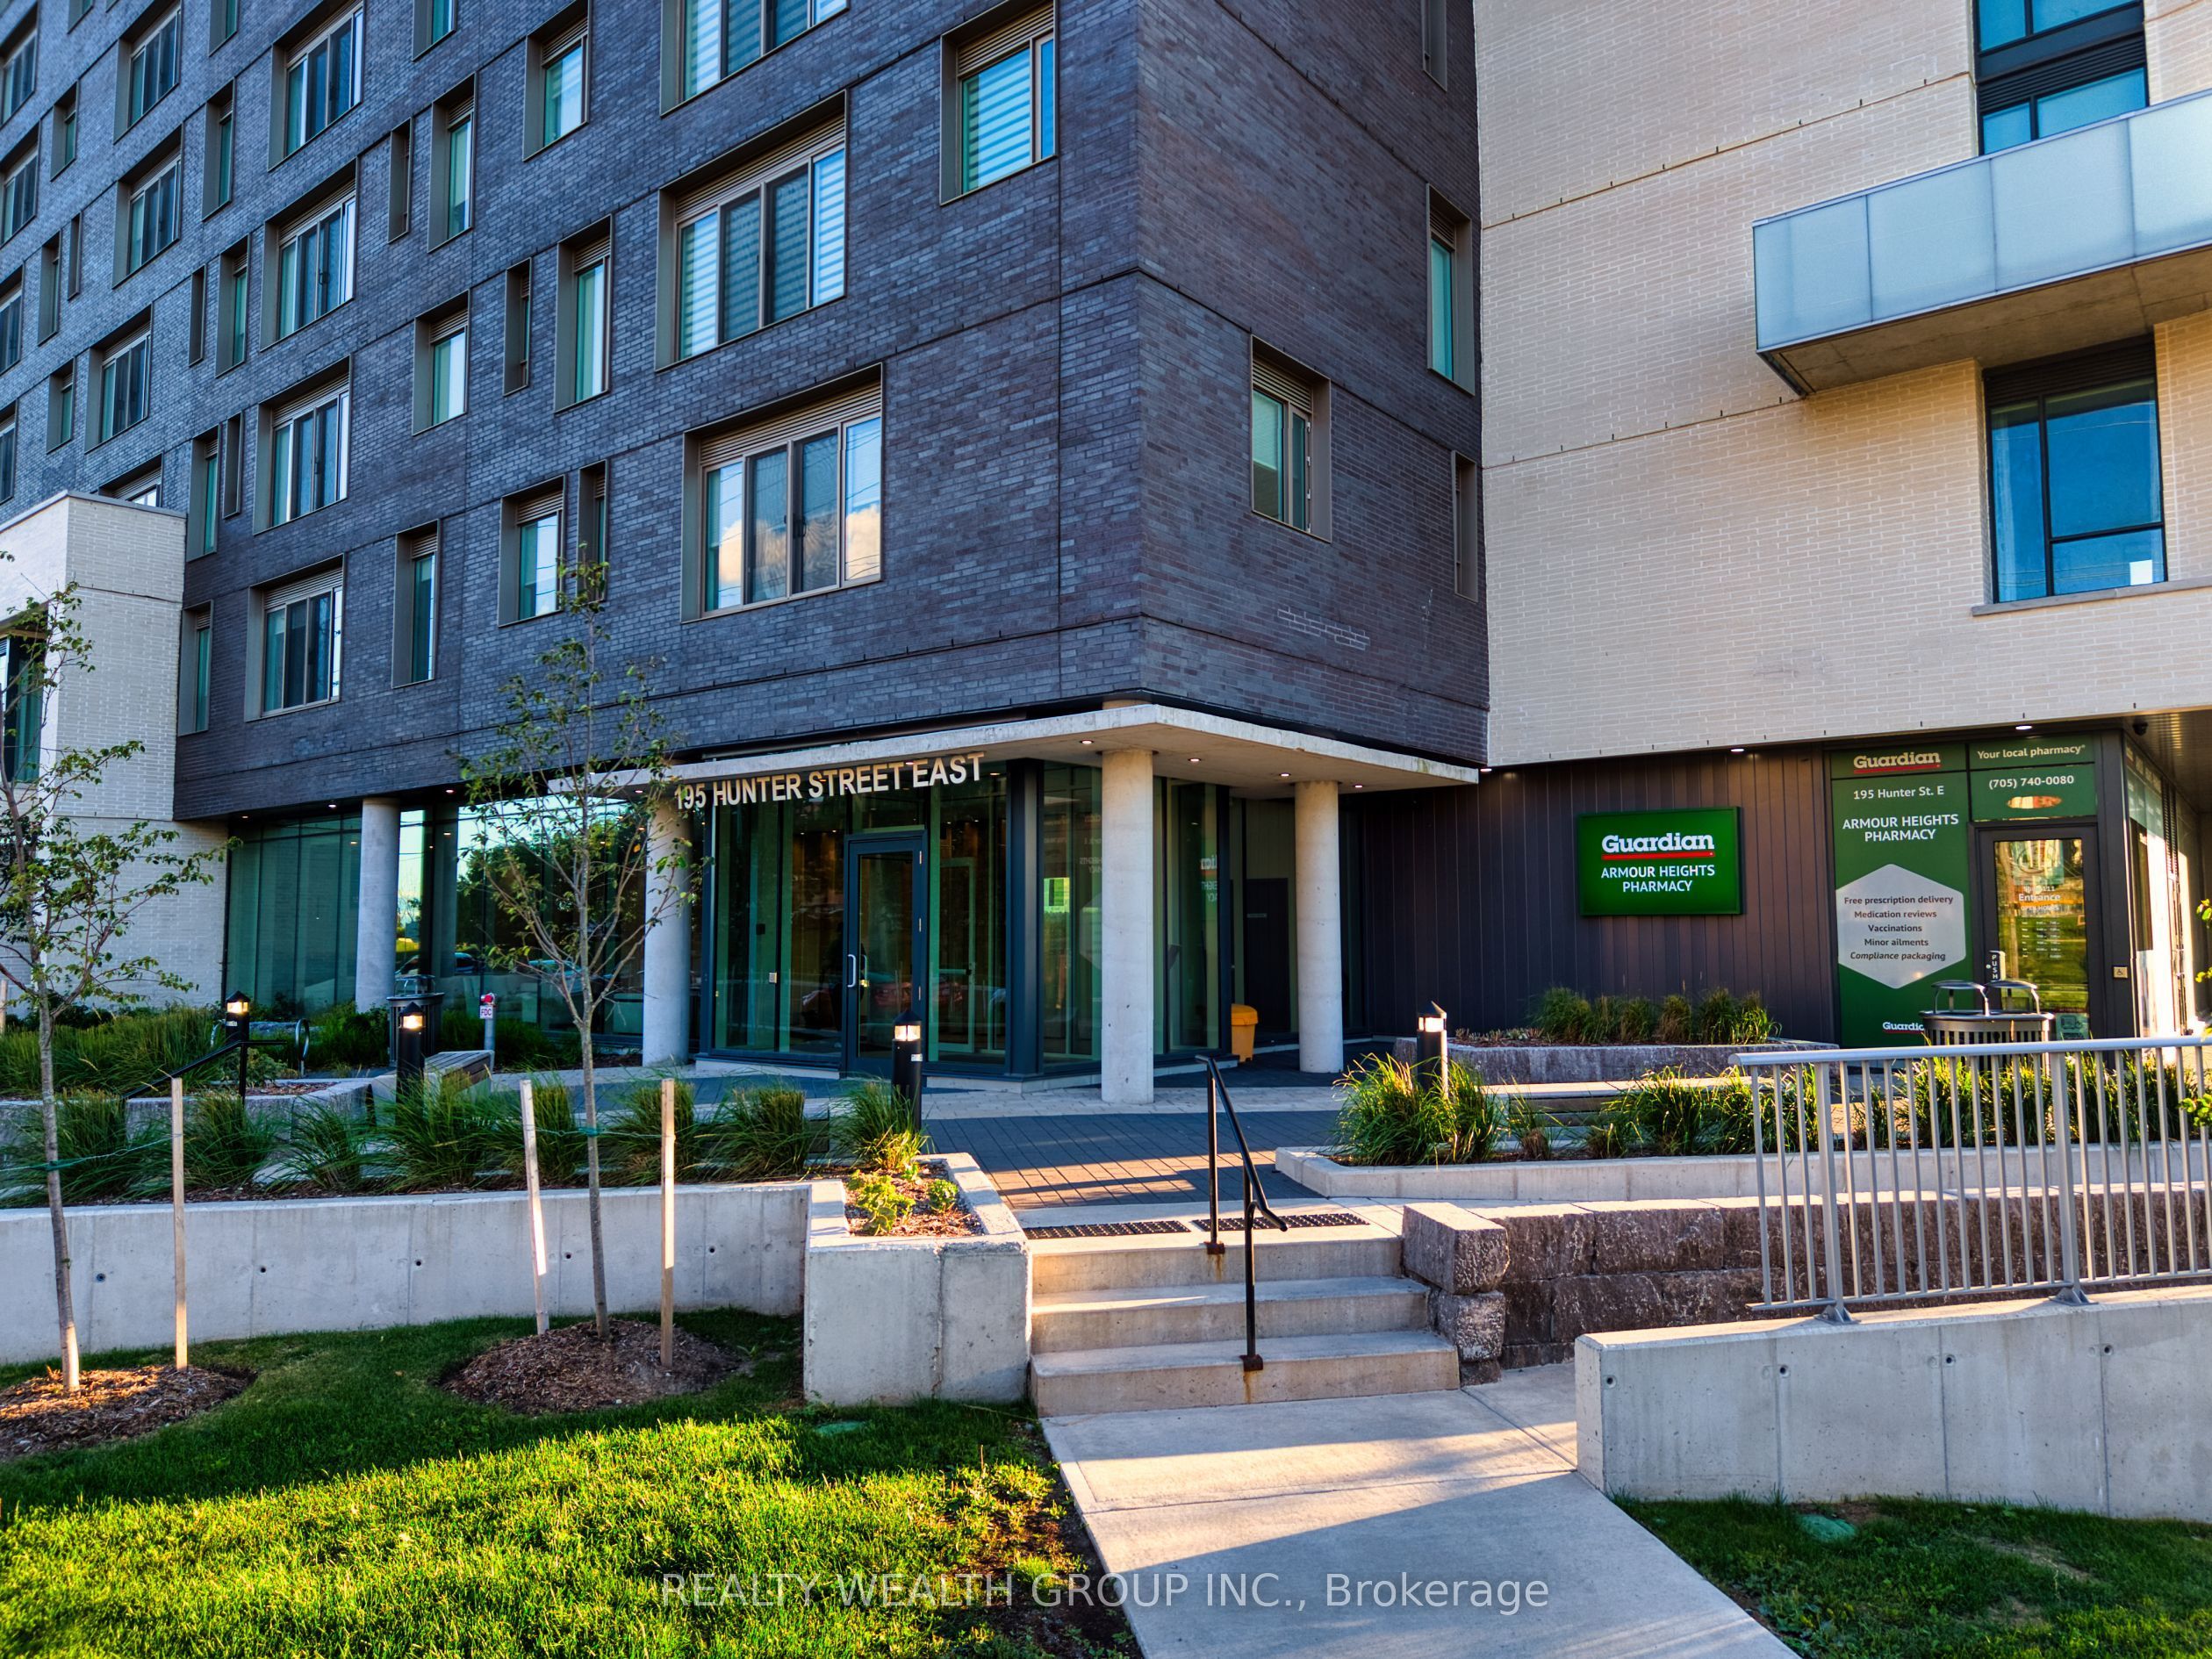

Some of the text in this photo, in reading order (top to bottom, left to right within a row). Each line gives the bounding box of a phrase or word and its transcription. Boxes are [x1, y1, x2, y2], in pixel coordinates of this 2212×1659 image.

[1853, 751, 1942, 769] Guardian
[1977, 750, 2000, 759] Your
[2002, 748, 2028, 758] local
[675, 752, 987, 811] 195 HUNTER STREET EAST
[1988, 775, 2074, 790] (705) 740-0080
[1853, 786, 1944, 800] 195 Hunter St. E
[1842, 814, 1959, 830] ARMOUR HEIGHTS
[1601, 832, 1714, 853] Guardian
[1864, 829, 1936, 842] PHARMACY
[1601, 865, 1715, 879] ARMOUR HEIGHTS
[1622, 880, 1692, 893] PHARMACY
[1864, 895, 1915, 905] prescription
[1917, 895, 1954, 905] delivery
[1850, 952, 1946, 961] Compliance packaging
[1882, 1021, 1925, 1031] Guardia
